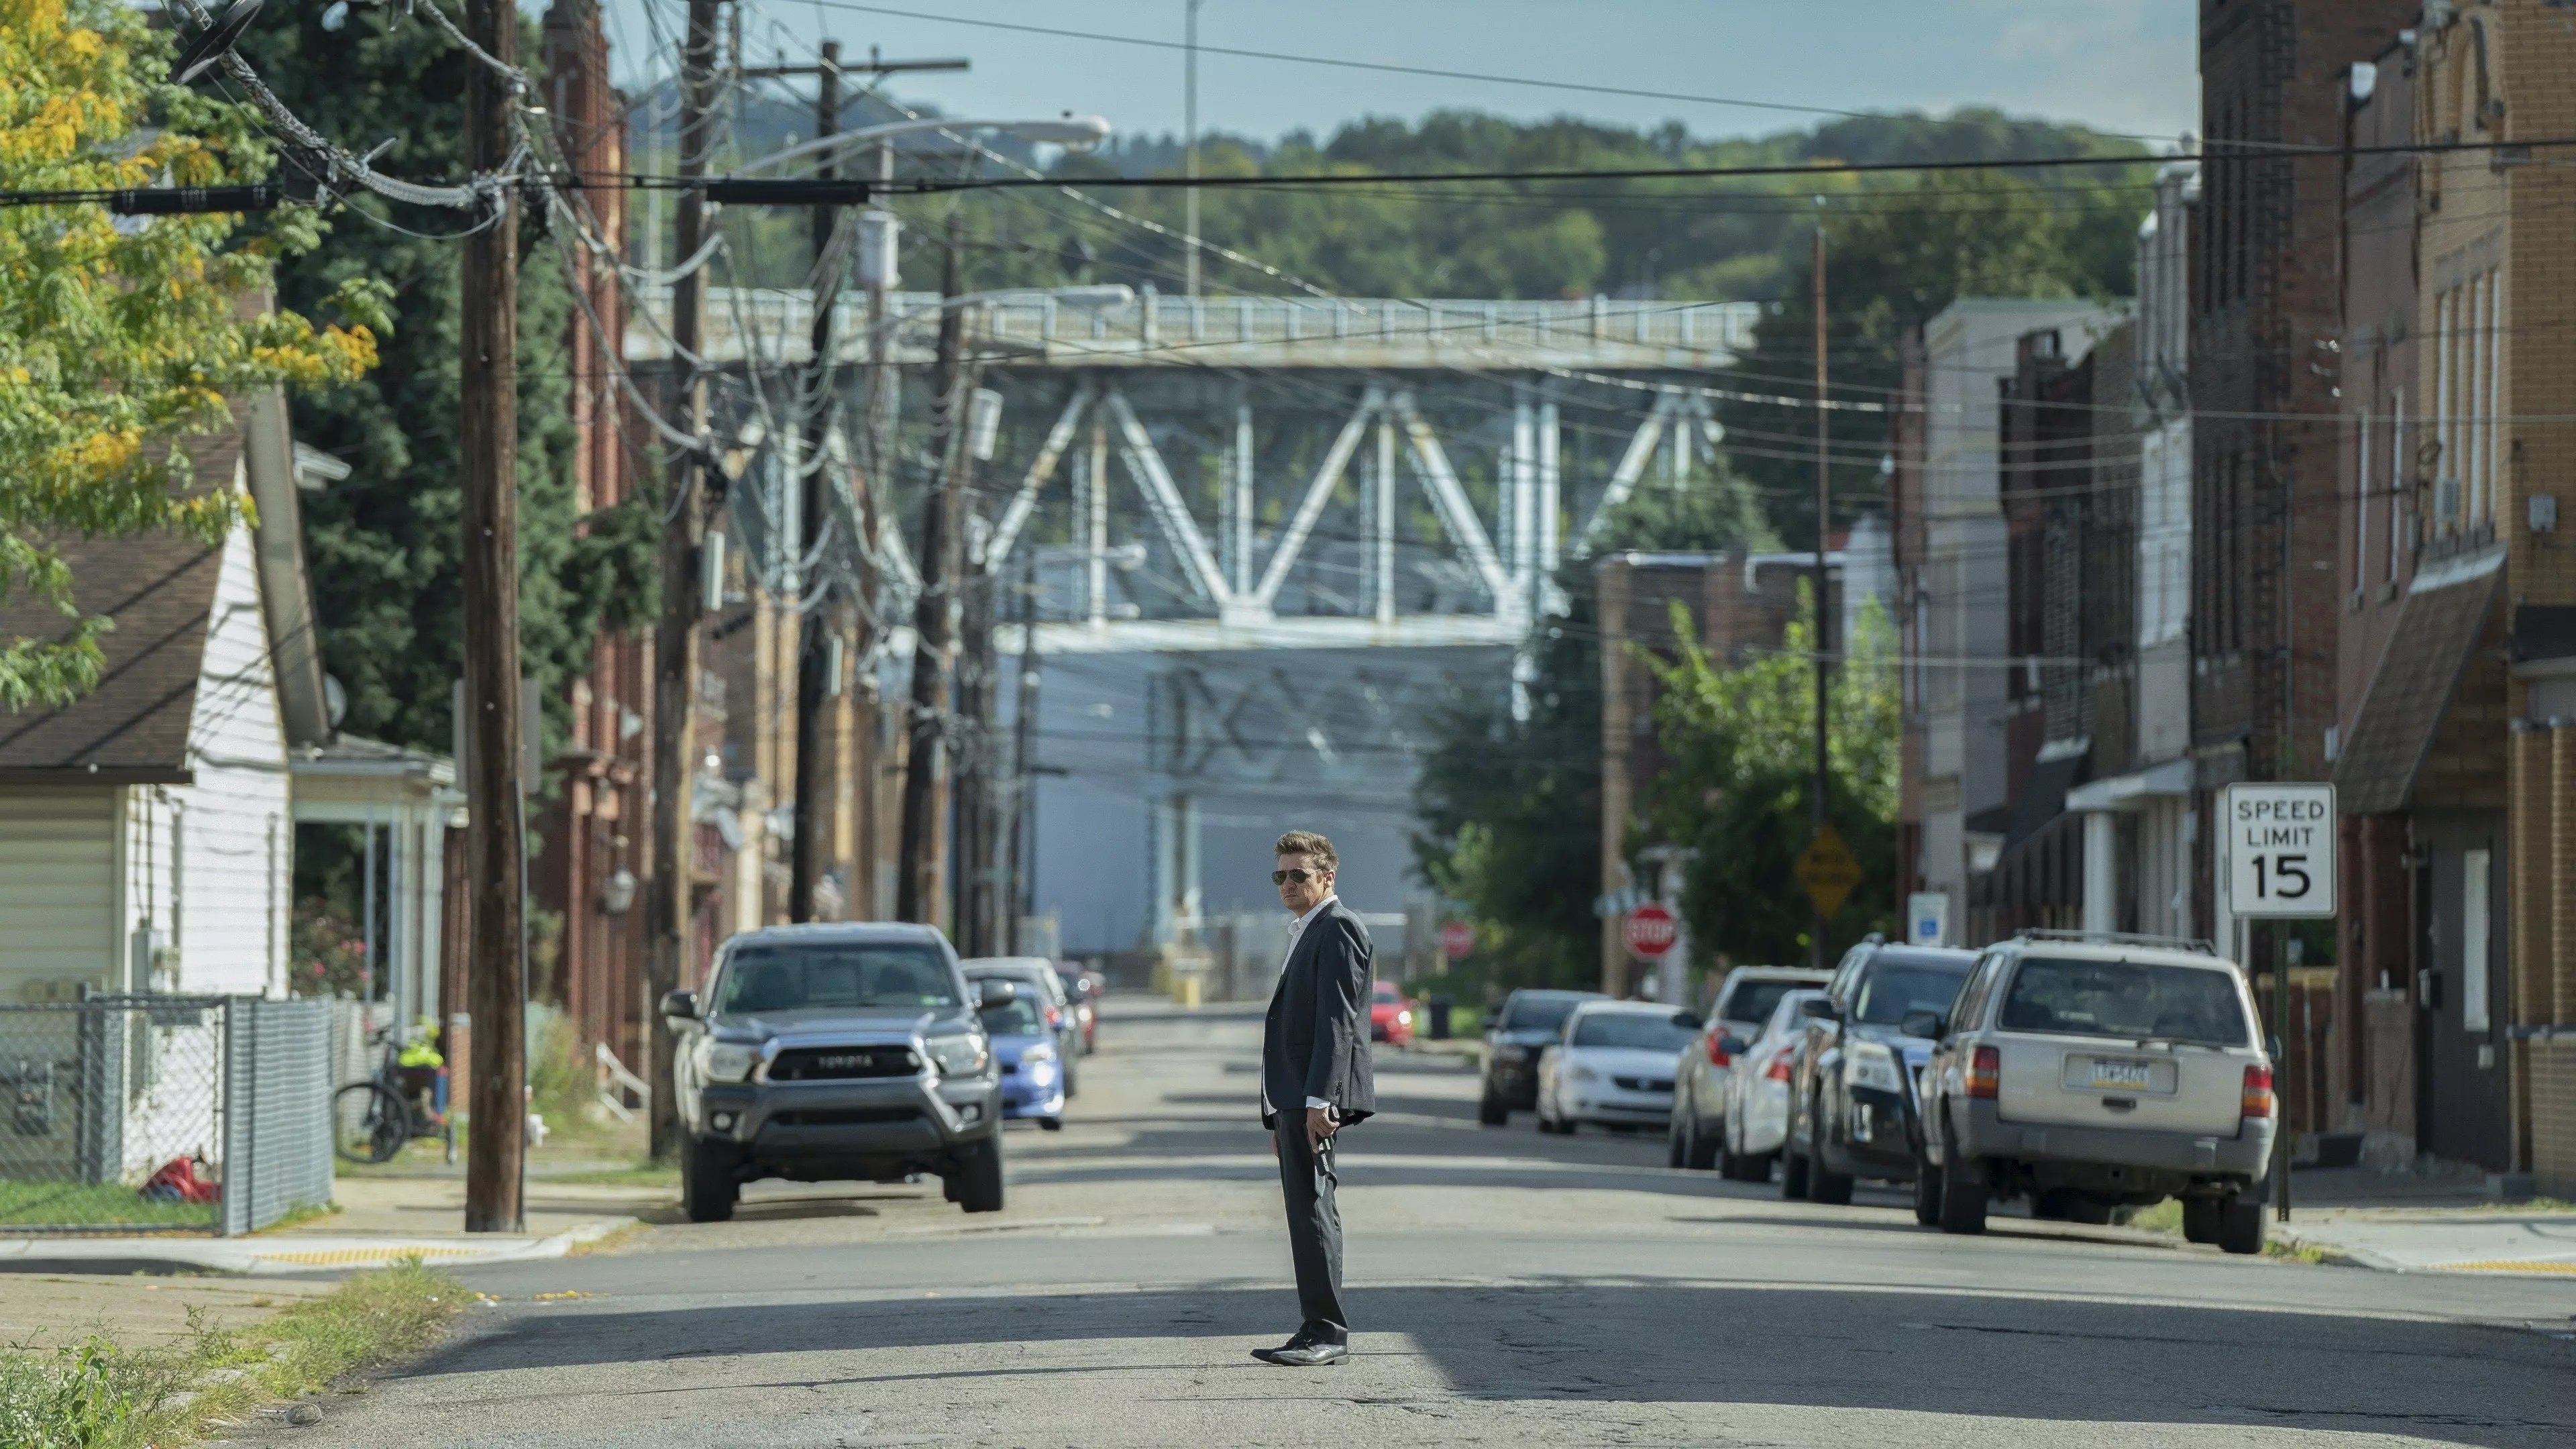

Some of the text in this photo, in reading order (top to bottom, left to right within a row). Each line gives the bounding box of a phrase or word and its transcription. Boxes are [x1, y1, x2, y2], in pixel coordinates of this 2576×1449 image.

[2239, 800, 2323, 820] SPEED
[2248, 828, 2314, 846] LIMIT
[2252, 855, 2310, 898] 15
[1628, 919, 1674, 941] STOP
[819, 1056, 873, 1068] TOYOTA
